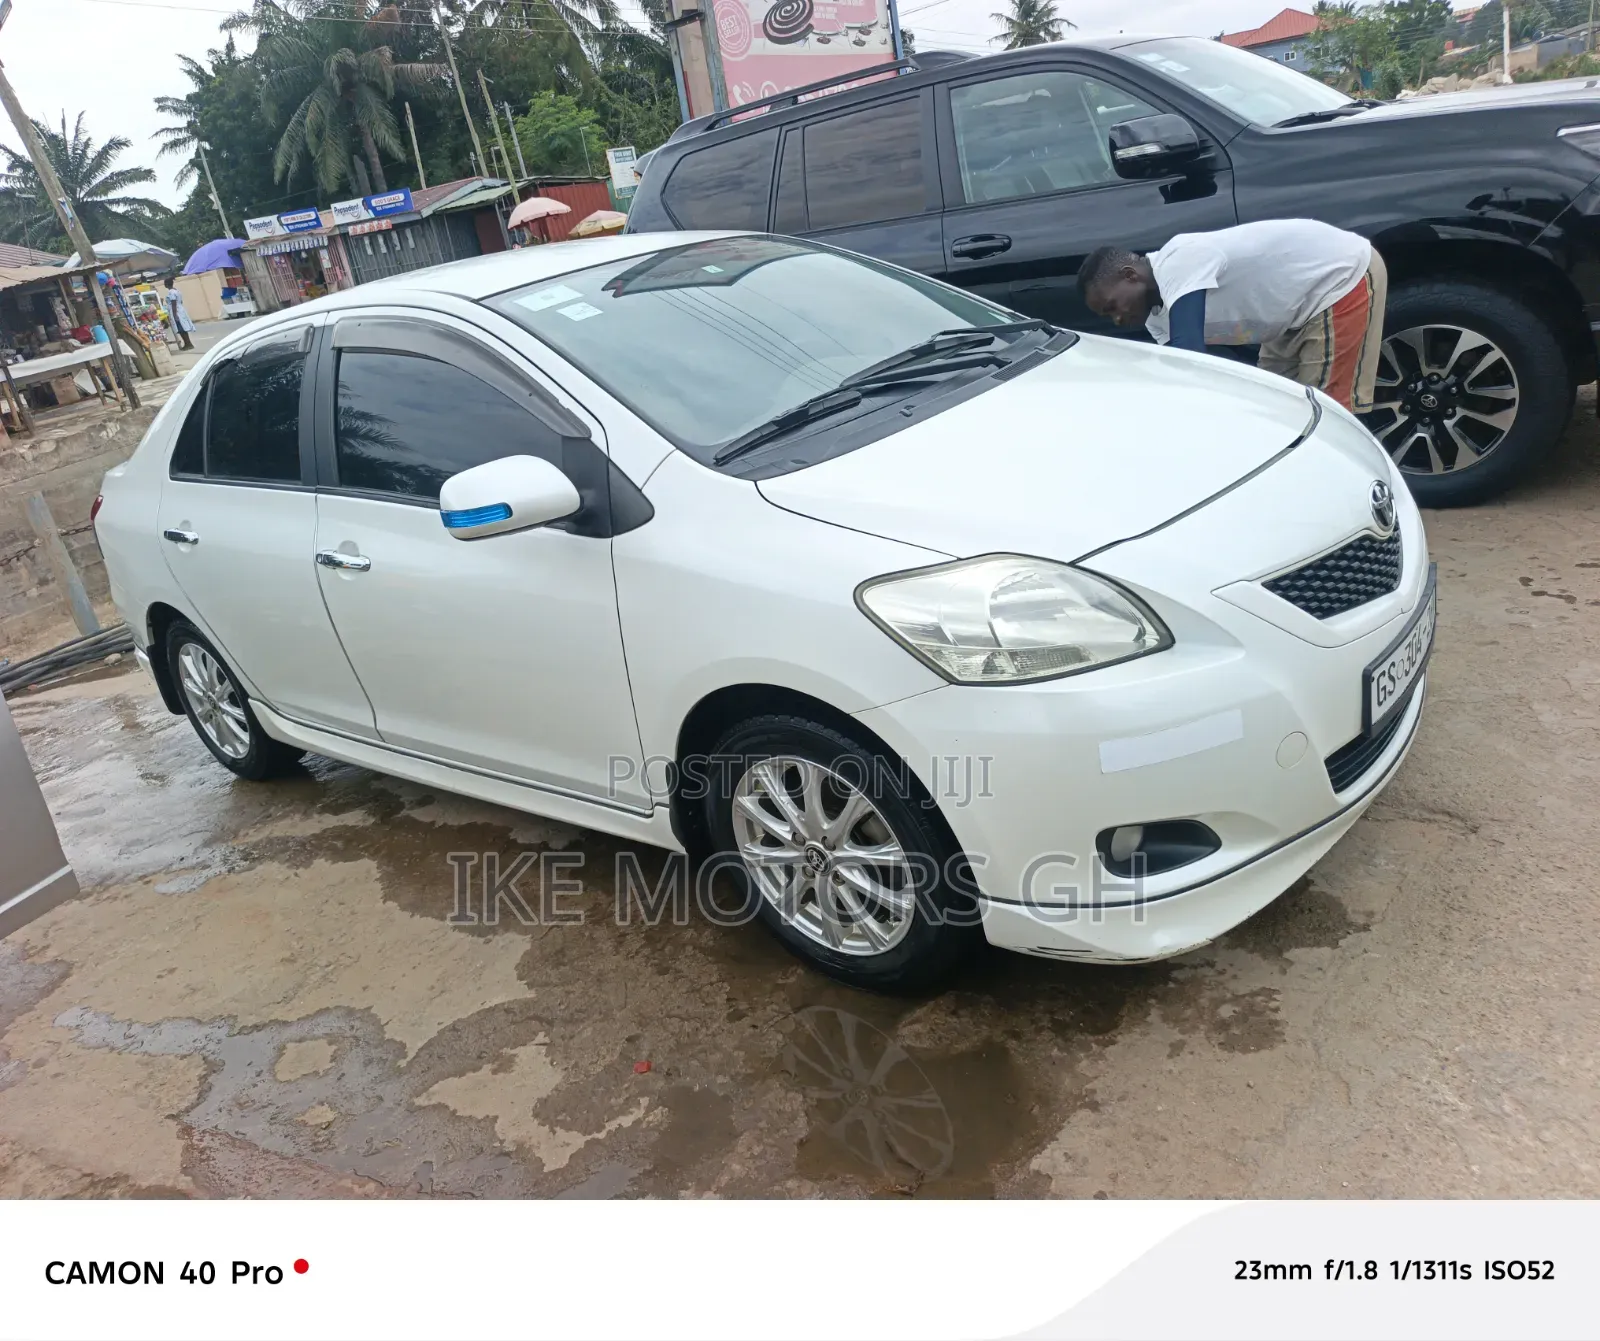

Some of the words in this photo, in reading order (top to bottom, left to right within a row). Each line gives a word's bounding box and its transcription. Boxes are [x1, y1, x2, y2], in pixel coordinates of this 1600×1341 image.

[720, 15, 737, 30] BEST
[333, 203, 359, 214] Pepsodent
[248, 220, 273, 231] Pepsodent
[1376, 661, 1396, 707] GS
